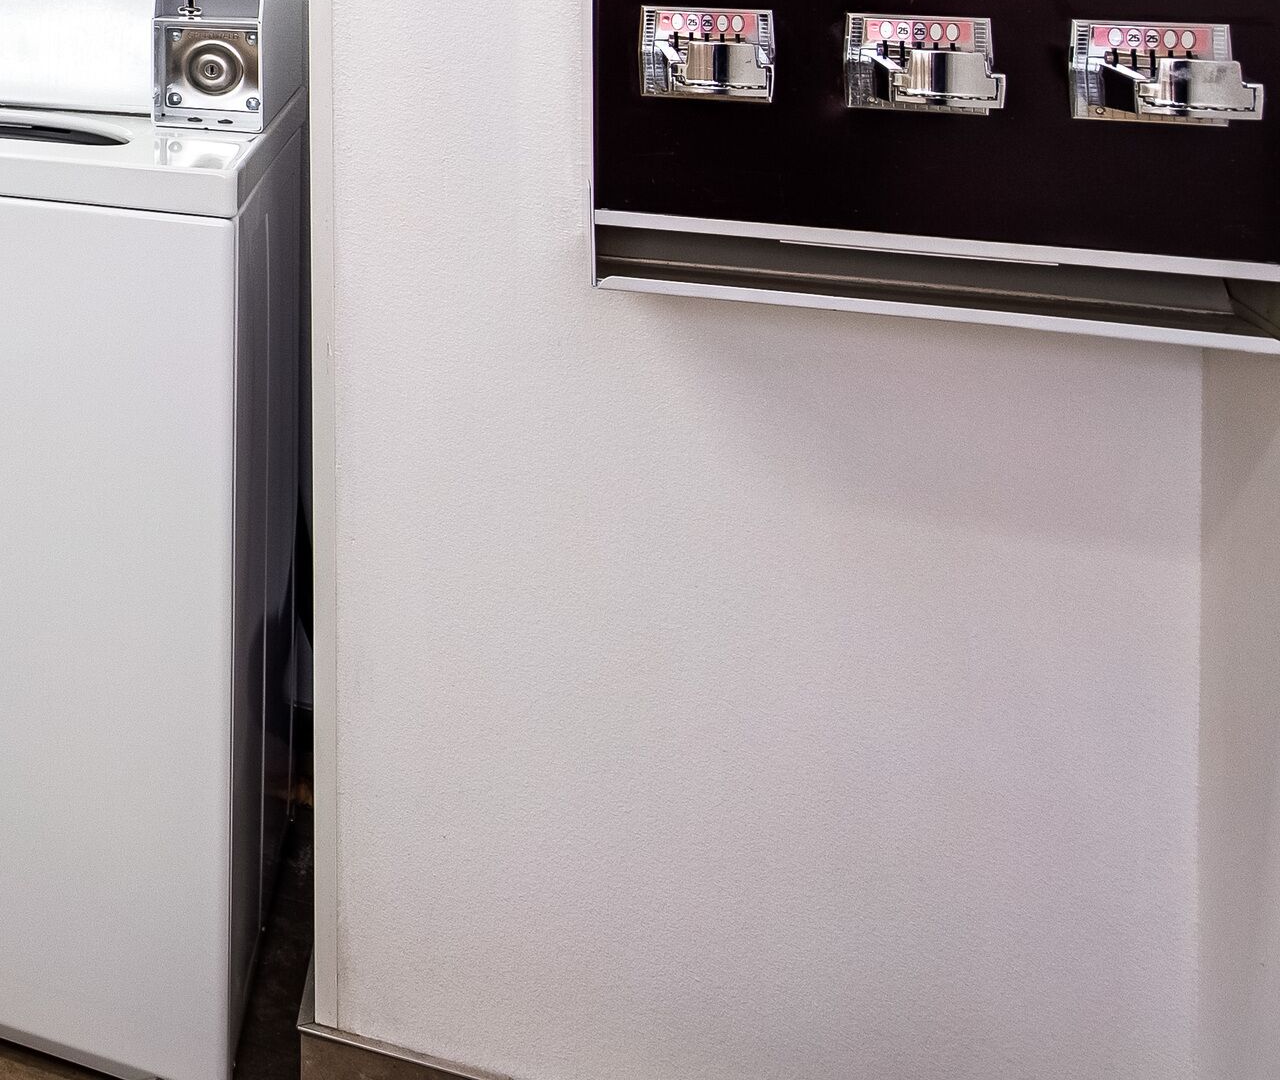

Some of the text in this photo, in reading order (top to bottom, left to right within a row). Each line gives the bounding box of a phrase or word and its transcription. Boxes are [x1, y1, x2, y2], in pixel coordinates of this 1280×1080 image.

[687, 18, 698, 26] 25
[702, 19, 713, 27] 25
[897, 26, 908, 35] 25
[914, 27, 925, 36] 25
[1128, 33, 1140, 42] 25
[1146, 34, 1158, 43] 25
